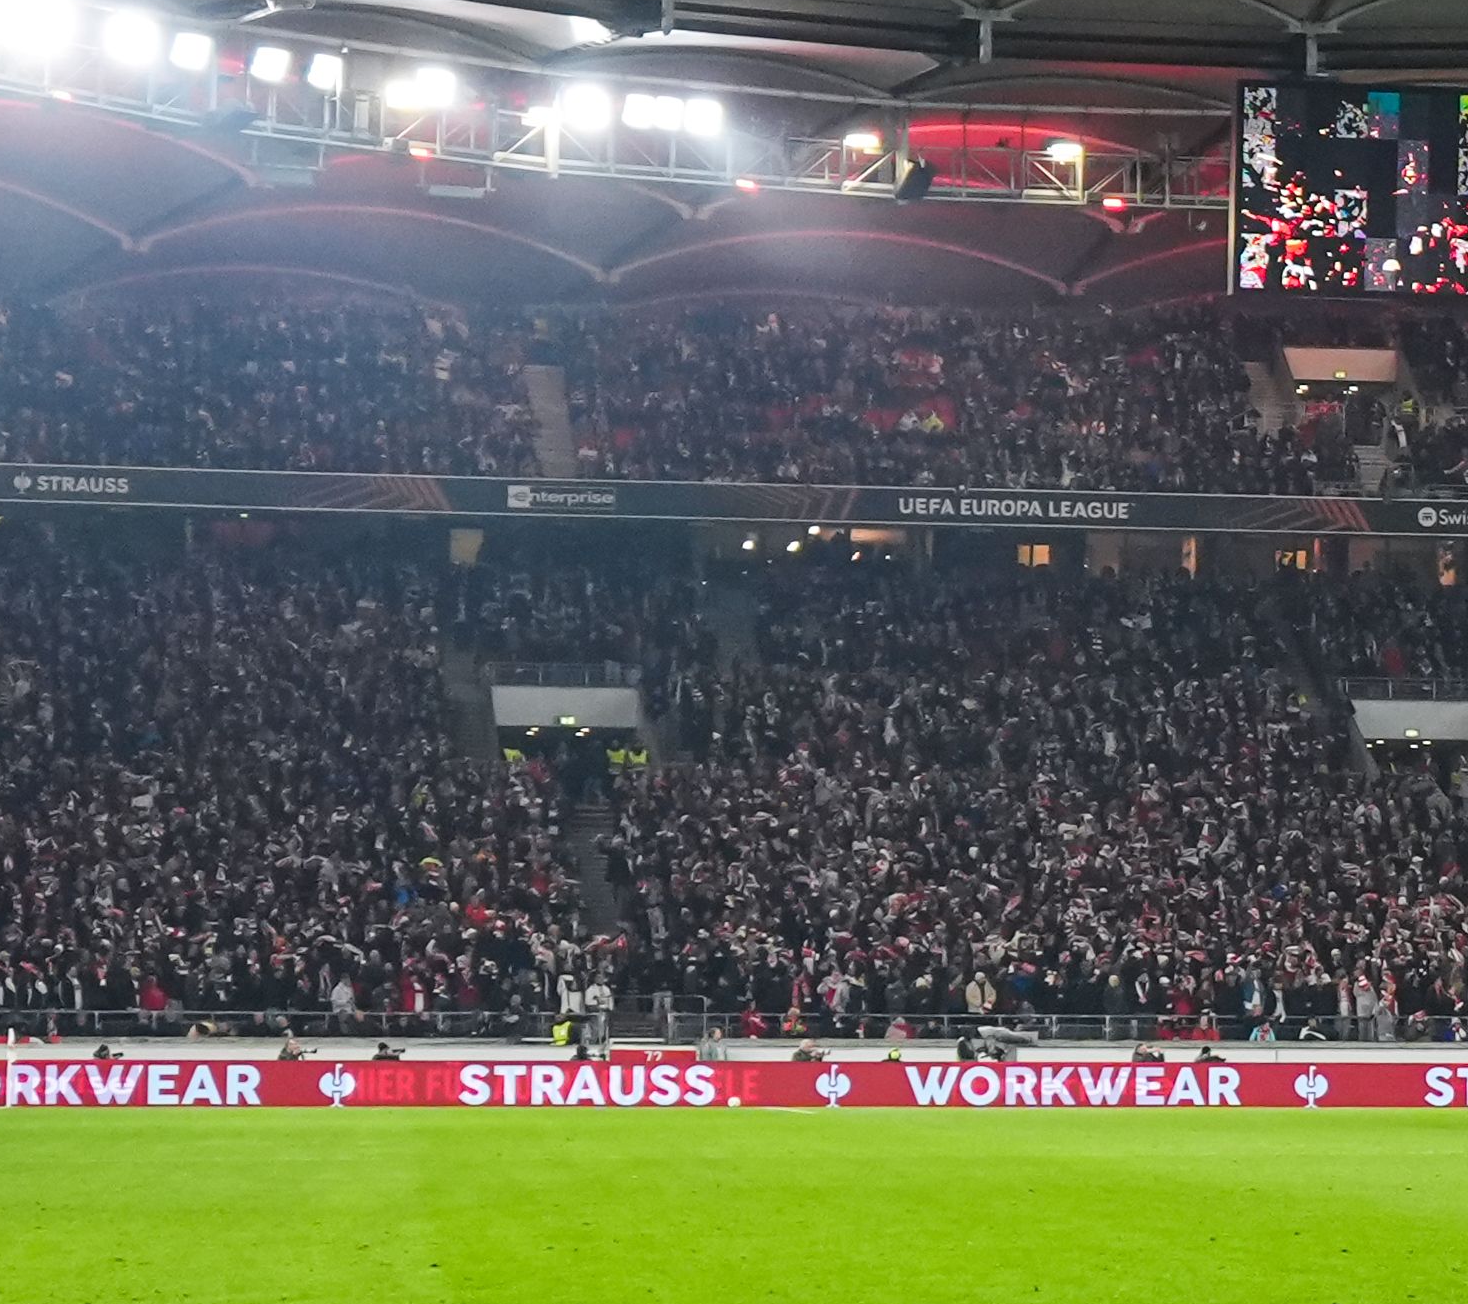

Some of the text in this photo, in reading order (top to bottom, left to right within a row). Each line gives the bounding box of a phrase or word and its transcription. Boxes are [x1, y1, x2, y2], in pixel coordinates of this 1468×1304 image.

[36, 475, 129, 494] STRAUSS
[898, 497, 1130, 519] UEFA EUROPA LEAGUE
[458, 1064, 716, 1106] STRAUSS
[905, 1065, 1241, 1107] WORKWEAR
